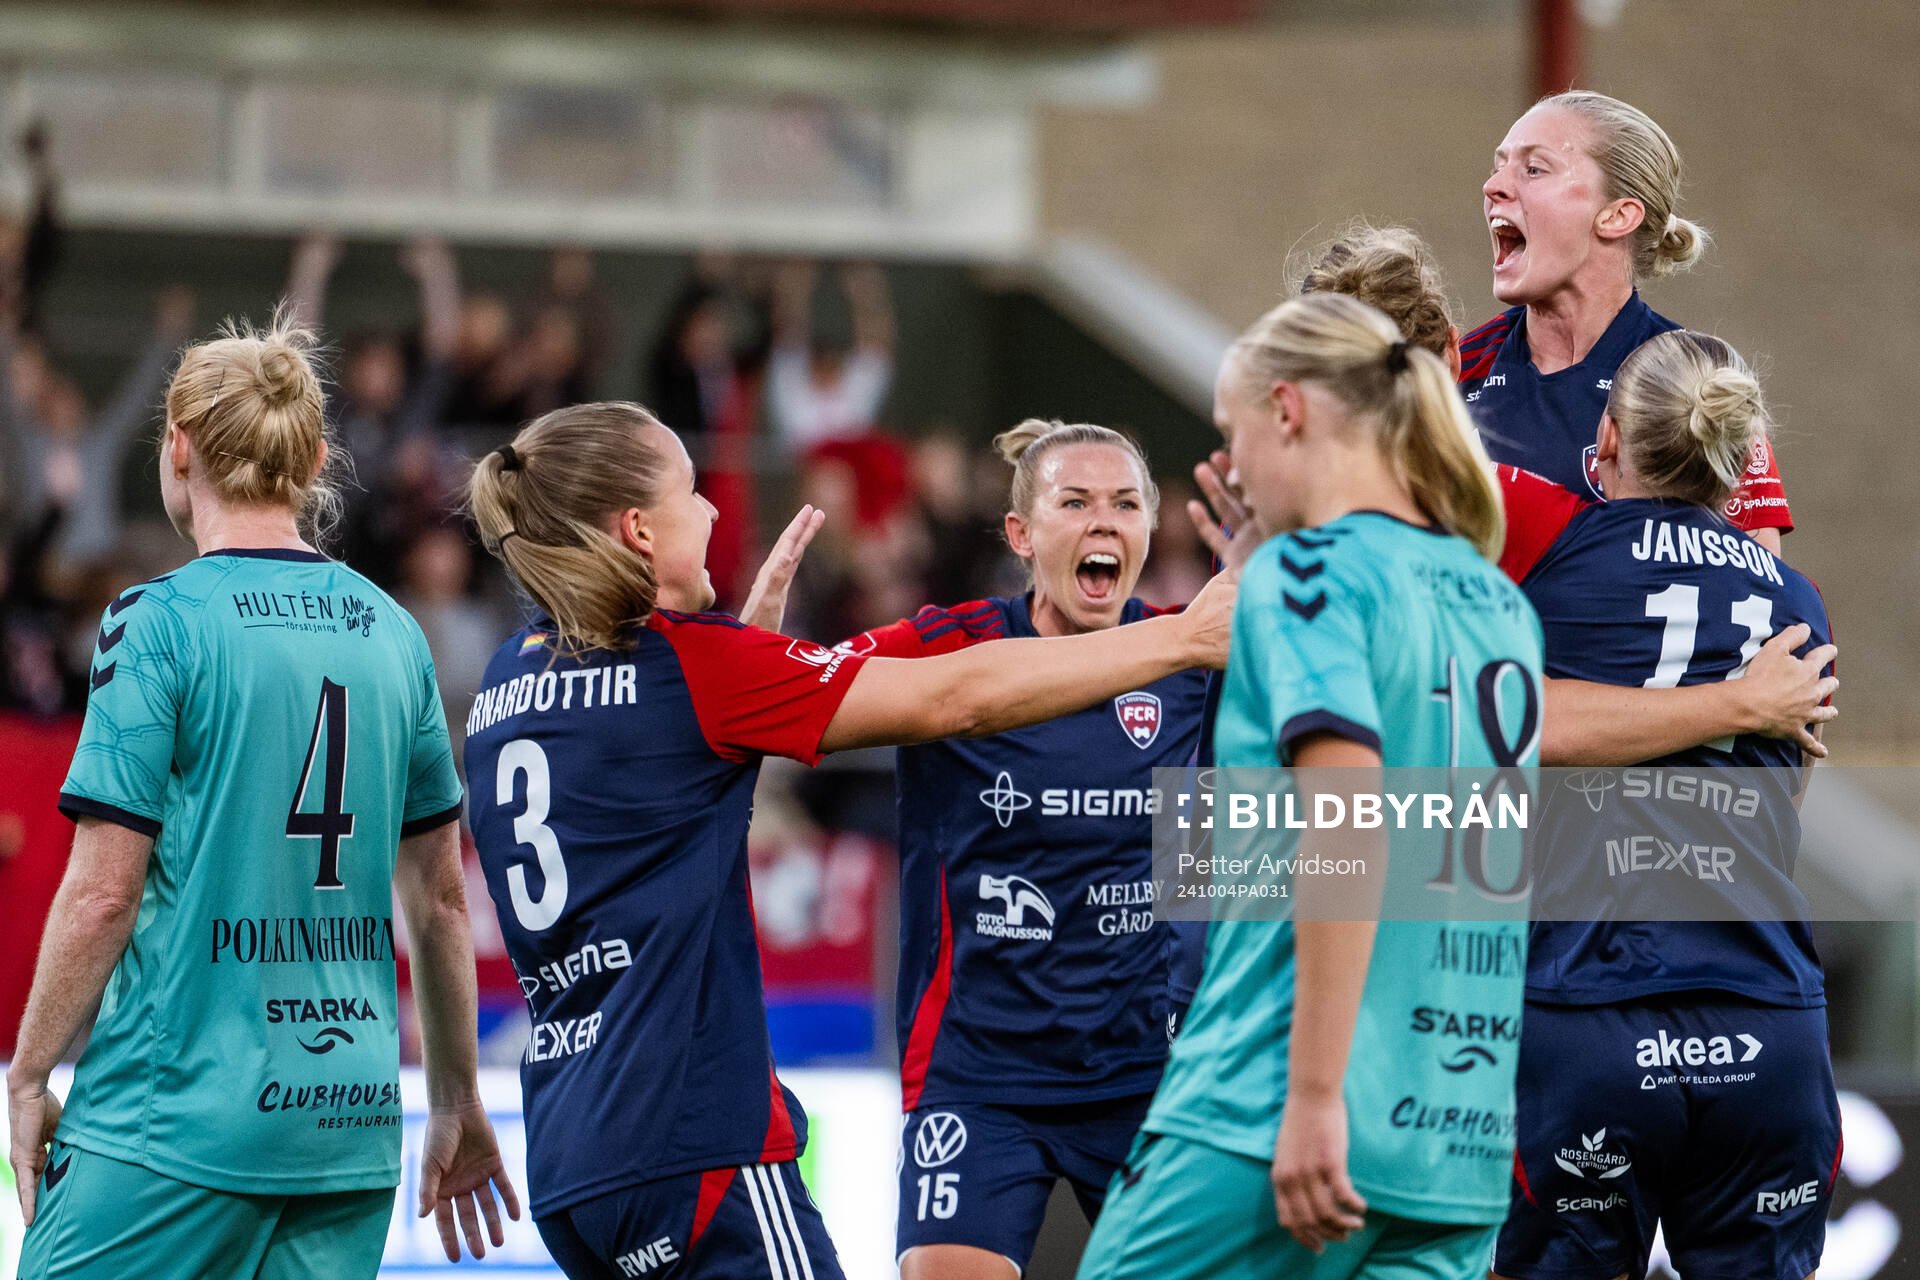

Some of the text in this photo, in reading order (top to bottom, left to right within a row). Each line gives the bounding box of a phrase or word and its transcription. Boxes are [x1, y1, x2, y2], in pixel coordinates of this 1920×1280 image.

[1631, 519, 1784, 586] JANSSON
[232, 591, 334, 619] HULTÉN
[1123, 705, 1156, 722] FCR
[286, 675, 355, 890] 4
[1427, 656, 1541, 898] 18
[496, 739, 569, 932] 3
[1086, 879, 1165, 906] MELLBY
[976, 913, 1006, 927] OTTO
[976, 923, 1053, 941] MAGNUSSON
[1098, 909, 1155, 936] GÅRD
[266, 998, 379, 1024] STARKA
[1636, 1029, 1735, 1068] akea
[1657, 1072, 1756, 1086] PART OF ELEDA GROUP
[1561, 1147, 1626, 1165] ROSENGÅRD
[1576, 1161, 1608, 1171] CENTRUM
[916, 1172, 961, 1221] 15
[1556, 1192, 1628, 1213] Scandic
[1756, 1179, 1819, 1214] RWE
[616, 1236, 680, 1279] RWE
